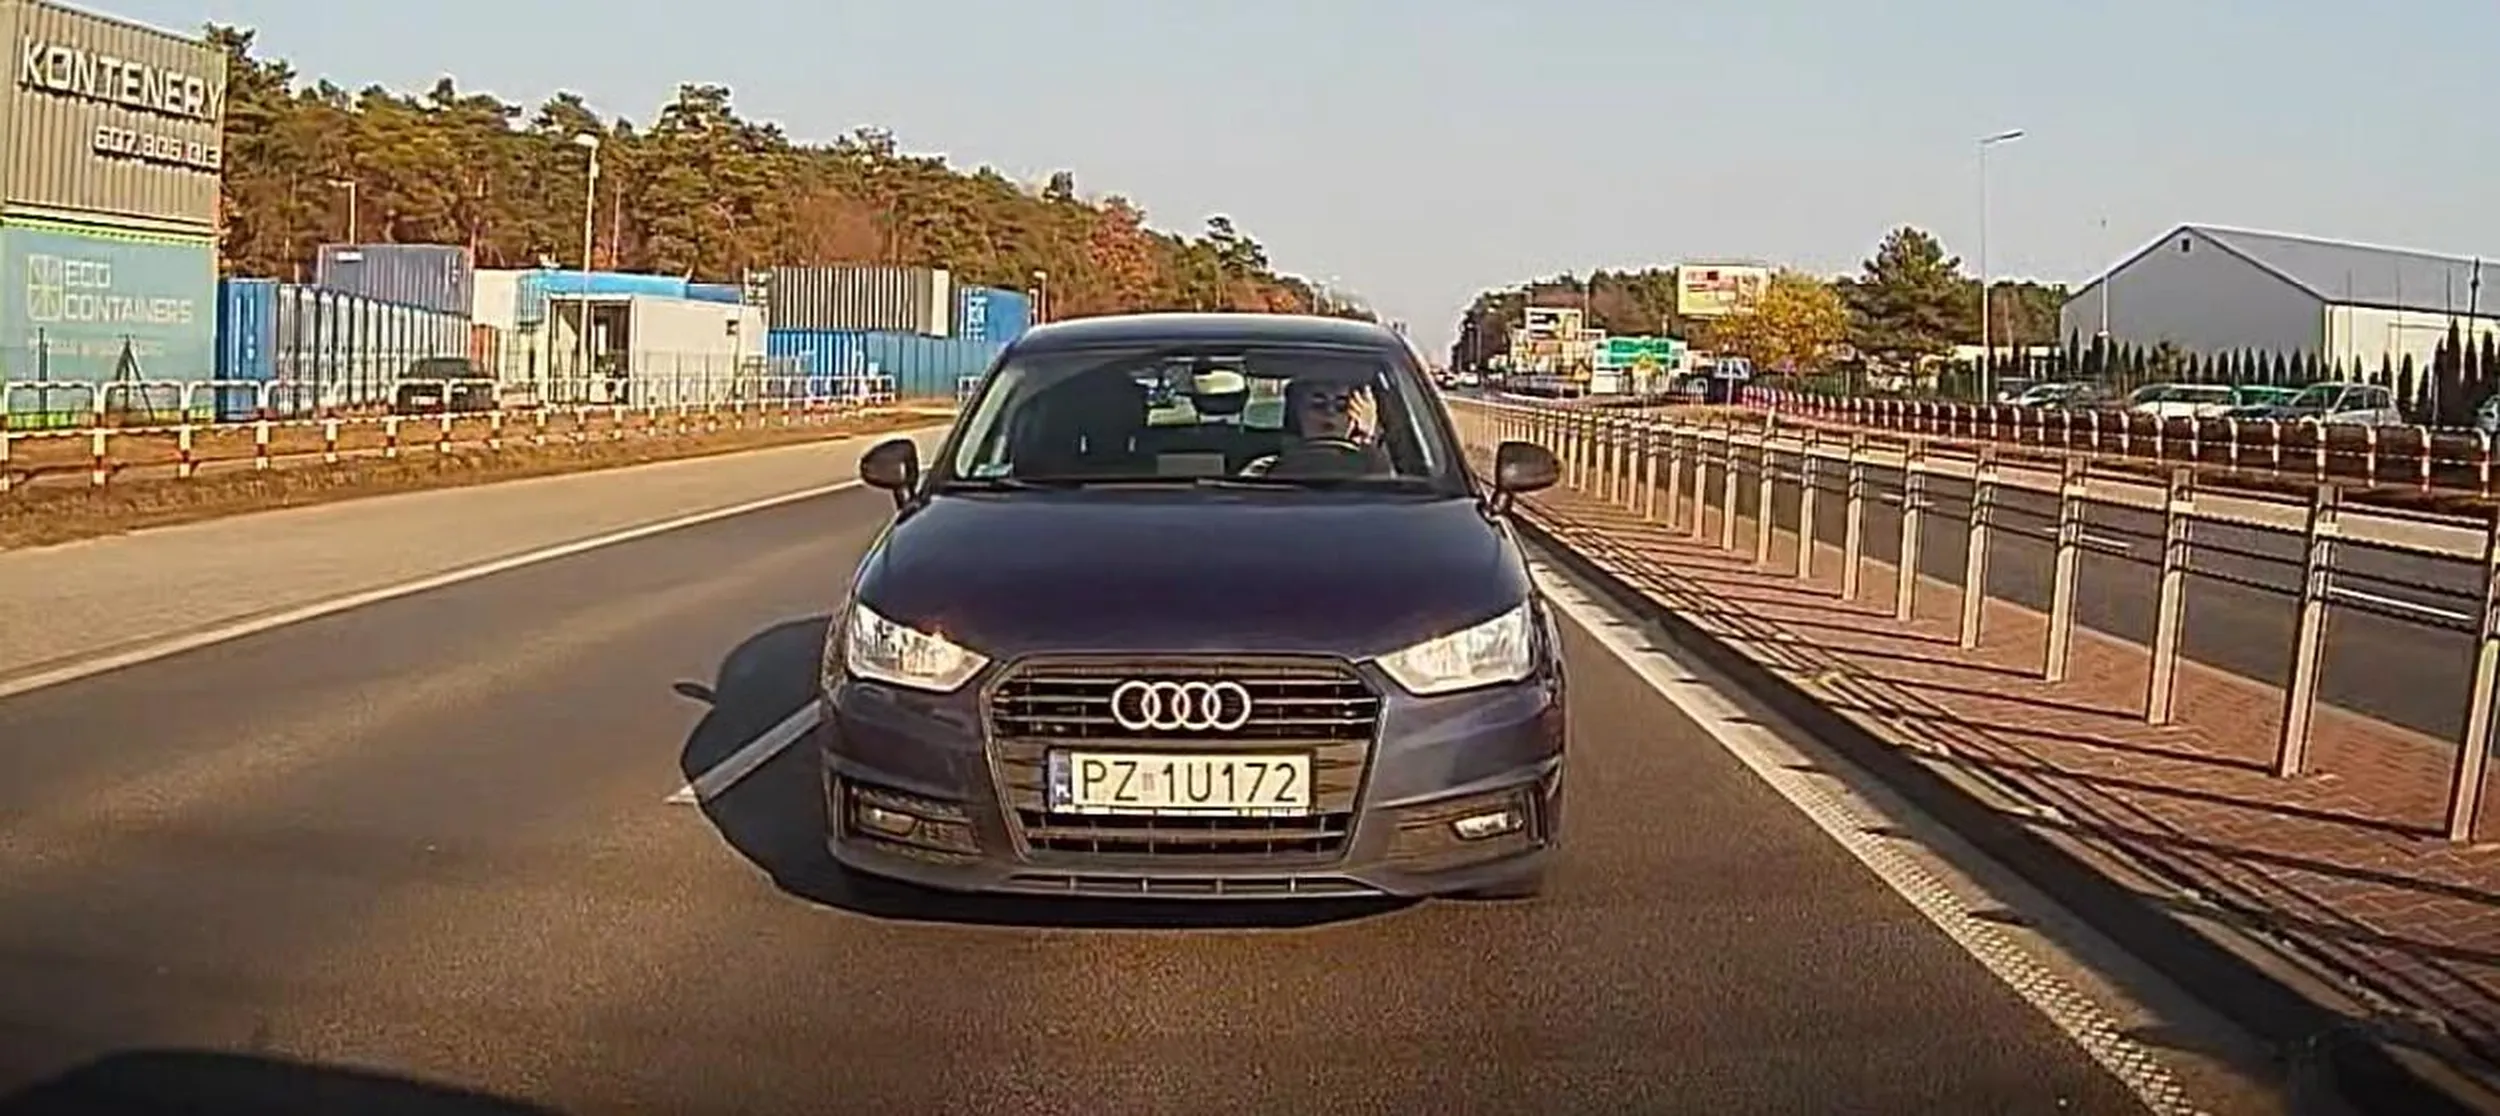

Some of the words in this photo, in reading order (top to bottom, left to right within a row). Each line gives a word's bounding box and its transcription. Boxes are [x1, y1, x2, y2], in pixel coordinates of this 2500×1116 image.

[21, 34, 224, 120] KONTENERY
[64, 260, 111, 289] ECO
[63, 293, 194, 324] CONTAINERS
[1082, 759, 1139, 801] PZ
[1162, 761, 1298, 804] 1U172
